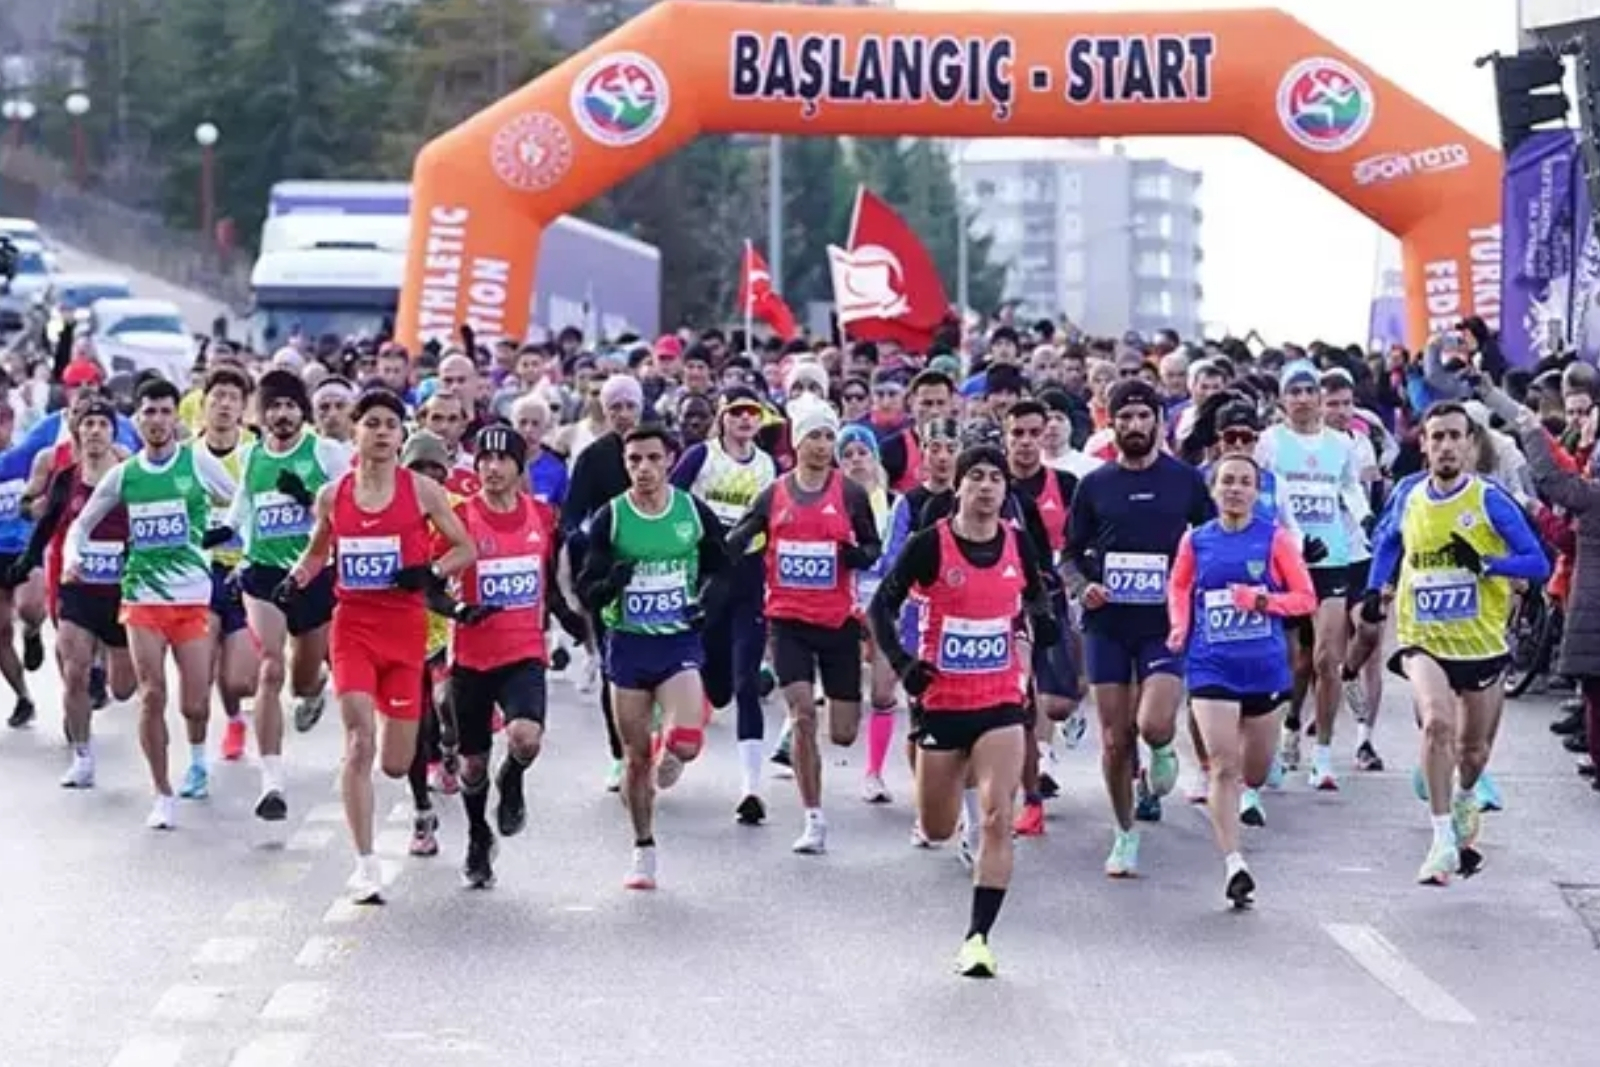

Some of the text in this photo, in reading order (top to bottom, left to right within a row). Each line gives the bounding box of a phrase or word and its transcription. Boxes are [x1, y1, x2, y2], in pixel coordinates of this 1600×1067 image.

[733, 32, 1013, 119] BAŞLANGIÇ
[1067, 36, 1214, 101] START
[136, 515, 184, 537] 0786
[259, 504, 304, 527] 0787
[81, 556, 118, 573] 494
[344, 555, 396, 577] 1657
[781, 556, 831, 577] 0502
[483, 573, 536, 597] 0499
[1105, 572, 1161, 591] 0784
[628, 591, 683, 613] 0785
[1418, 587, 1472, 611] 0777
[945, 636, 1006, 659] 0490
